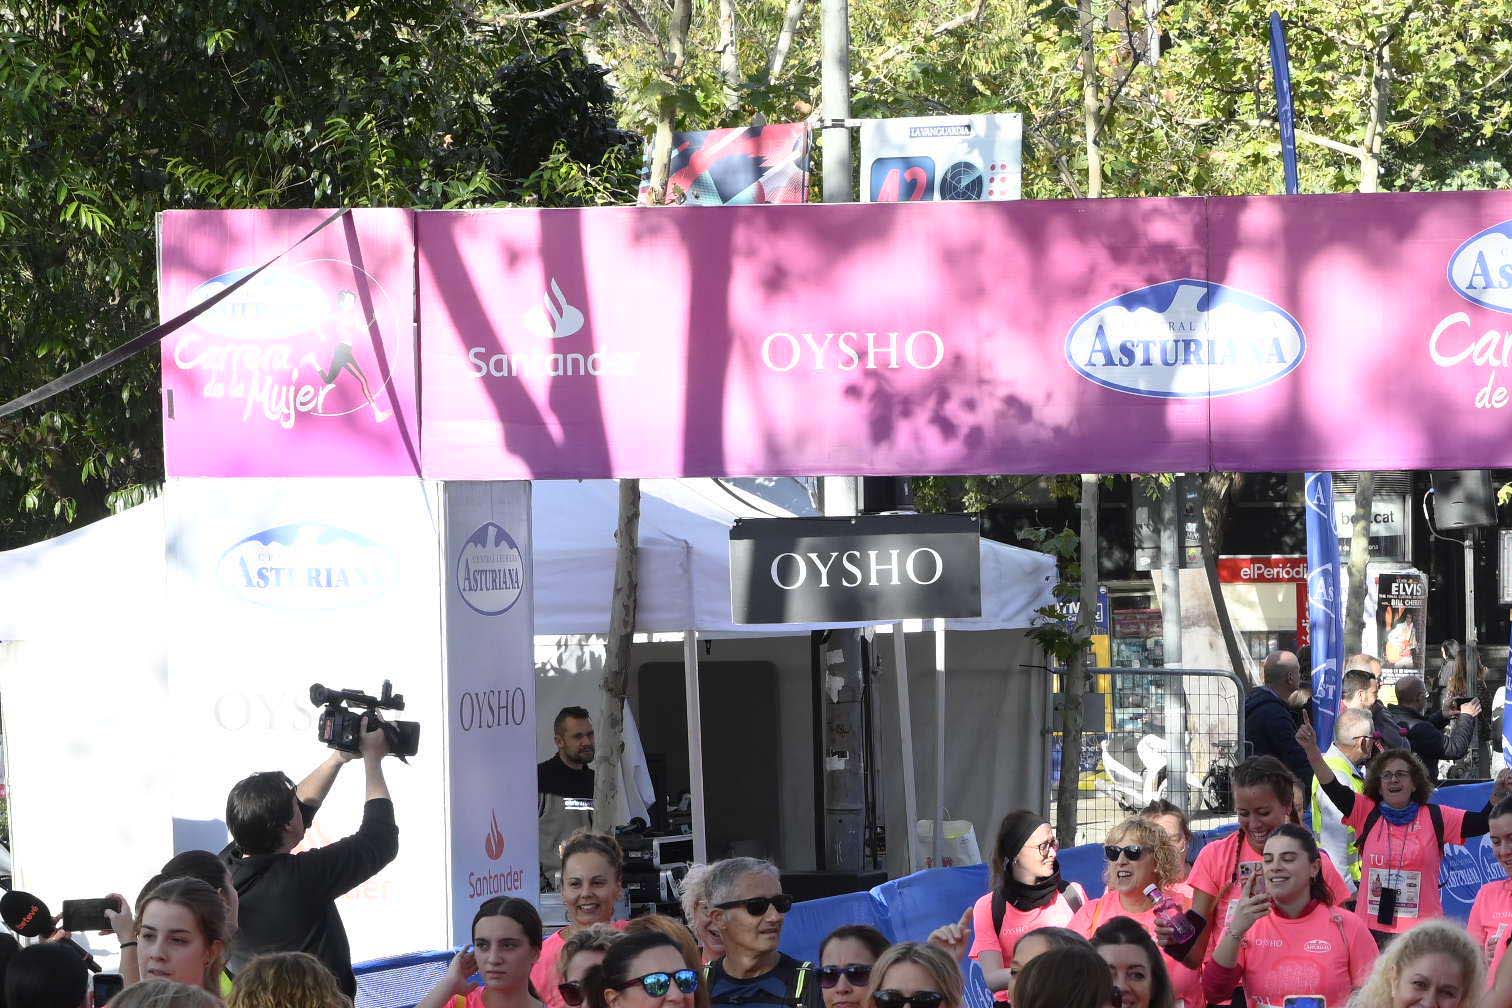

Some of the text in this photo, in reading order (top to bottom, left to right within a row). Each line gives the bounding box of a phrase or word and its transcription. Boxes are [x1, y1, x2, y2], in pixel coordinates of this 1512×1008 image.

[468, 346, 640, 378] Santander
[761, 330, 945, 372] OYSHO
[1086, 320, 1287, 367] ASTURIANA
[243, 367, 337, 430] Mujer
[1475, 367, 1510, 408] de
[462, 557, 520, 593] ASTURIANA
[771, 547, 944, 590] OYSHO
[1391, 583, 1422, 596] ELVIS
[460, 687, 526, 731] OYSHO
[1369, 854, 1385, 866] TU
[469, 864, 524, 899] Santander
